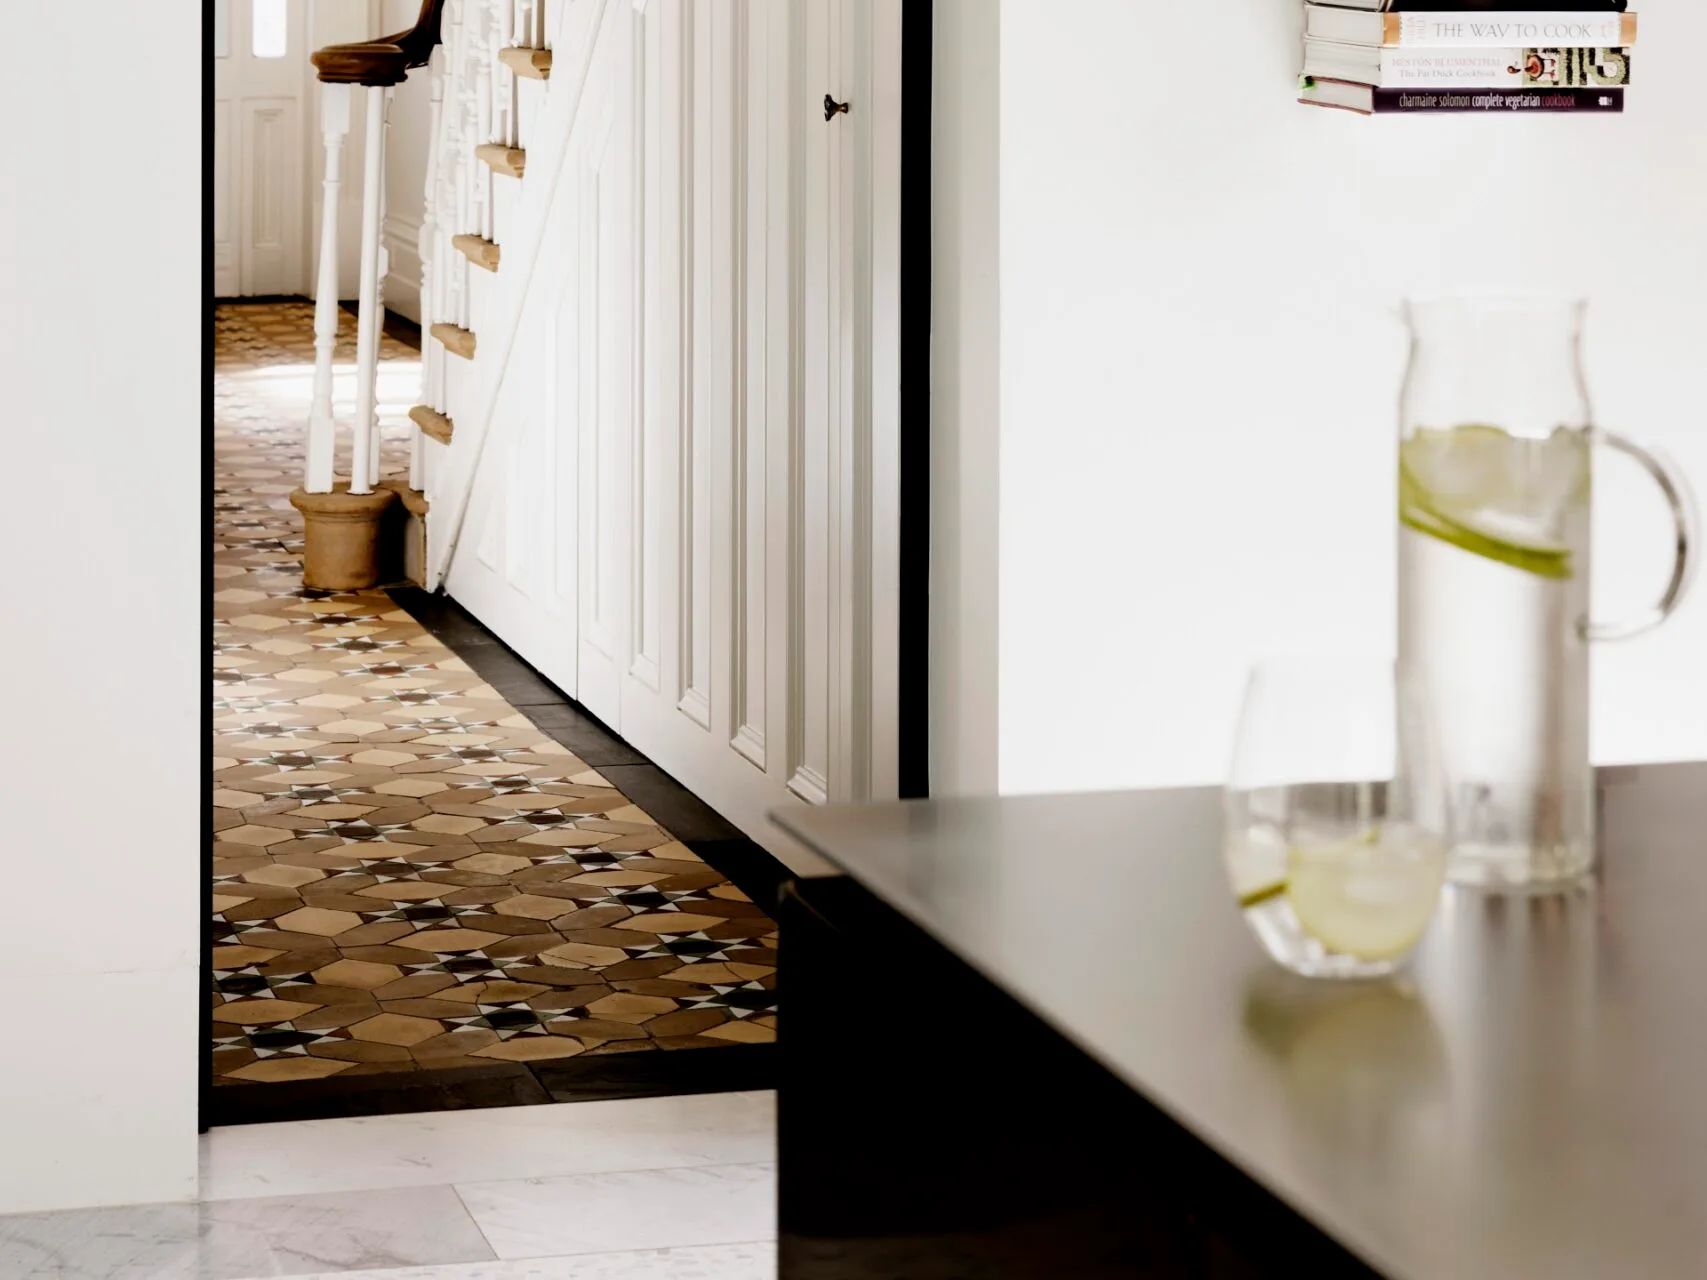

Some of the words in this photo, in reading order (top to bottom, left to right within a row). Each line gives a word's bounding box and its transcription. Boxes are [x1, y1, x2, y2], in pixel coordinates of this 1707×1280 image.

[1434, 23, 1465, 37] THE
[1469, 23, 1510, 38] WAY
[1514, 23, 1538, 38] TO
[1543, 23, 1592, 38] COOK
[1392, 57, 1431, 67] HESTON
[1434, 58, 1501, 67] BLUMENTHAL
[1400, 69, 1414, 78] The
[1417, 69, 1429, 78] Fat
[1433, 69, 1453, 78] Duck
[1456, 69, 1497, 78] Cookbook
[1399, 92, 1437, 107] charmaine
[1438, 92, 1470, 107] solomon
[1471, 92, 1504, 110] complete
[1504, 93, 1540, 110] vegetarian
[1541, 93, 1577, 107] cookbook
